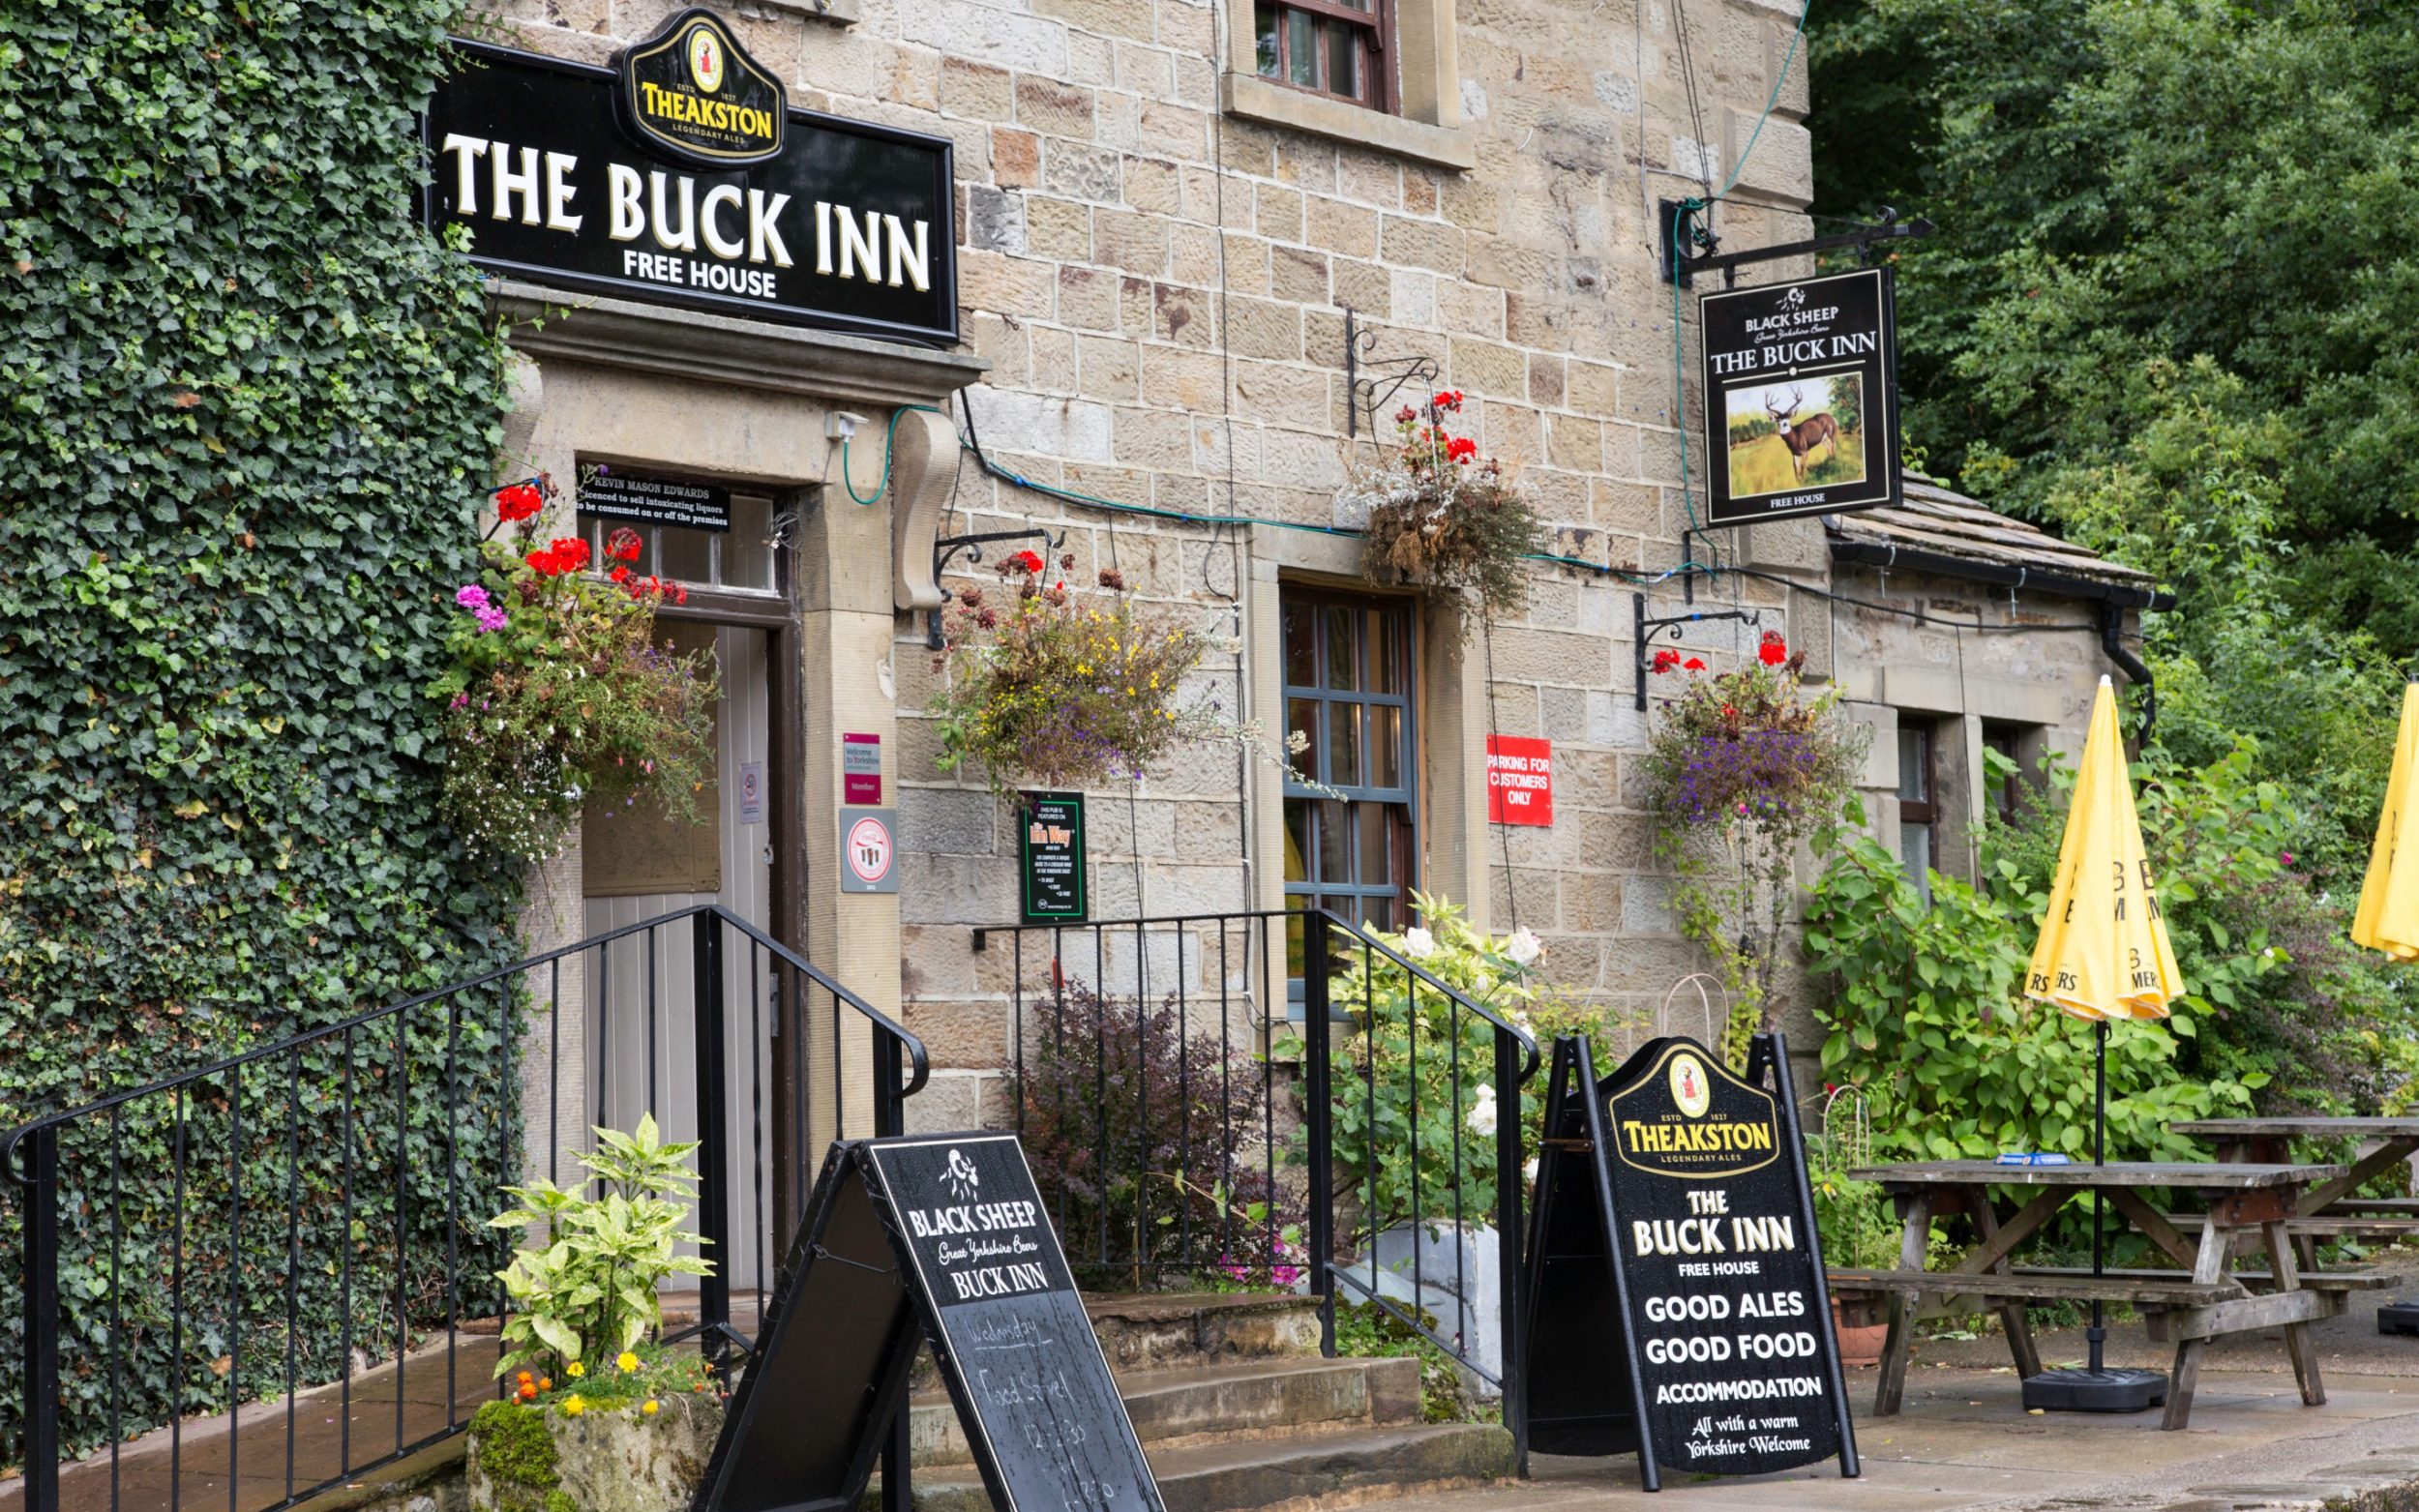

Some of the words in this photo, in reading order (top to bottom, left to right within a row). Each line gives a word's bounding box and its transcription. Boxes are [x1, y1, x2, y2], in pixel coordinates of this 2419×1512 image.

[677, 83, 695, 93] ESTD
[642, 81, 772, 139] THEAKSTON
[672, 124, 722, 140] LEGENDARY
[724, 134, 744, 144] ALES
[442, 133, 582, 233] THE
[607, 163, 794, 268] BUCK
[815, 200, 931, 291] INN
[624, 249, 683, 285] FREE
[690, 261, 777, 299] HOUSE
[1746, 313, 1790, 333] BLACK
[1793, 306, 1839, 325] SHEEP
[1711, 349, 1758, 374] THE
[1763, 338, 1827, 368] BUCK
[1831, 331, 1877, 357] INN
[594, 477, 624, 489] KEVIN
[627, 481, 661, 493] MASON
[664, 486, 709, 499] EDWARDS
[1770, 496, 1793, 509] FREE
[1794, 492, 1826, 506] HOUSE
[585, 502, 596, 512] be
[598, 504, 640, 517] consumed
[641, 509, 652, 518] on
[653, 510, 663, 519] or
[664, 511, 677, 520] off
[677, 513, 691, 522] the
[693, 516, 728, 526] premises
[619, 493, 628, 503] to
[630, 494, 644, 505] sell
[646, 497, 695, 512] intoxicating
[696, 503, 724, 515] liquors
[1487, 755, 1528, 771] PARKING
[1530, 758, 1549, 772] FOR
[1490, 772, 1547, 789] CUSTOMERS
[1508, 790, 1532, 805] ONLY
[1623, 1120, 1772, 1153] THEAKSTON
[1687, 1190, 1729, 1215] THE
[908, 1205, 979, 1237] BLACK
[976, 1201, 1036, 1230] SHEEP
[939, 1241, 968, 1265] Great
[966, 1237, 1012, 1262] Yorkshire
[1013, 1234, 1038, 1254] Beers
[1632, 1219, 1727, 1257] BUCK
[1730, 1216, 1796, 1253] INN
[950, 1266, 1011, 1299] BUCK
[1006, 1261, 1049, 1291] INN
[1678, 1262, 1711, 1277] FREE
[1714, 1260, 1760, 1276] HOUSE
[1645, 1294, 1730, 1322] GOOD
[1739, 1291, 1805, 1319] ALES
[1645, 1335, 1731, 1365] GOOD
[1740, 1332, 1817, 1359] FOOD
[1657, 1377, 1823, 1404] ACCOMMODATION
[1692, 1416, 1713, 1438] All
[1716, 1415, 1745, 1433] with
[1748, 1420, 1757, 1431] a
[1760, 1416, 1799, 1430] warm
[1685, 1437, 1747, 1459] Yorkshire
[1748, 1436, 1811, 1454] Welcome
